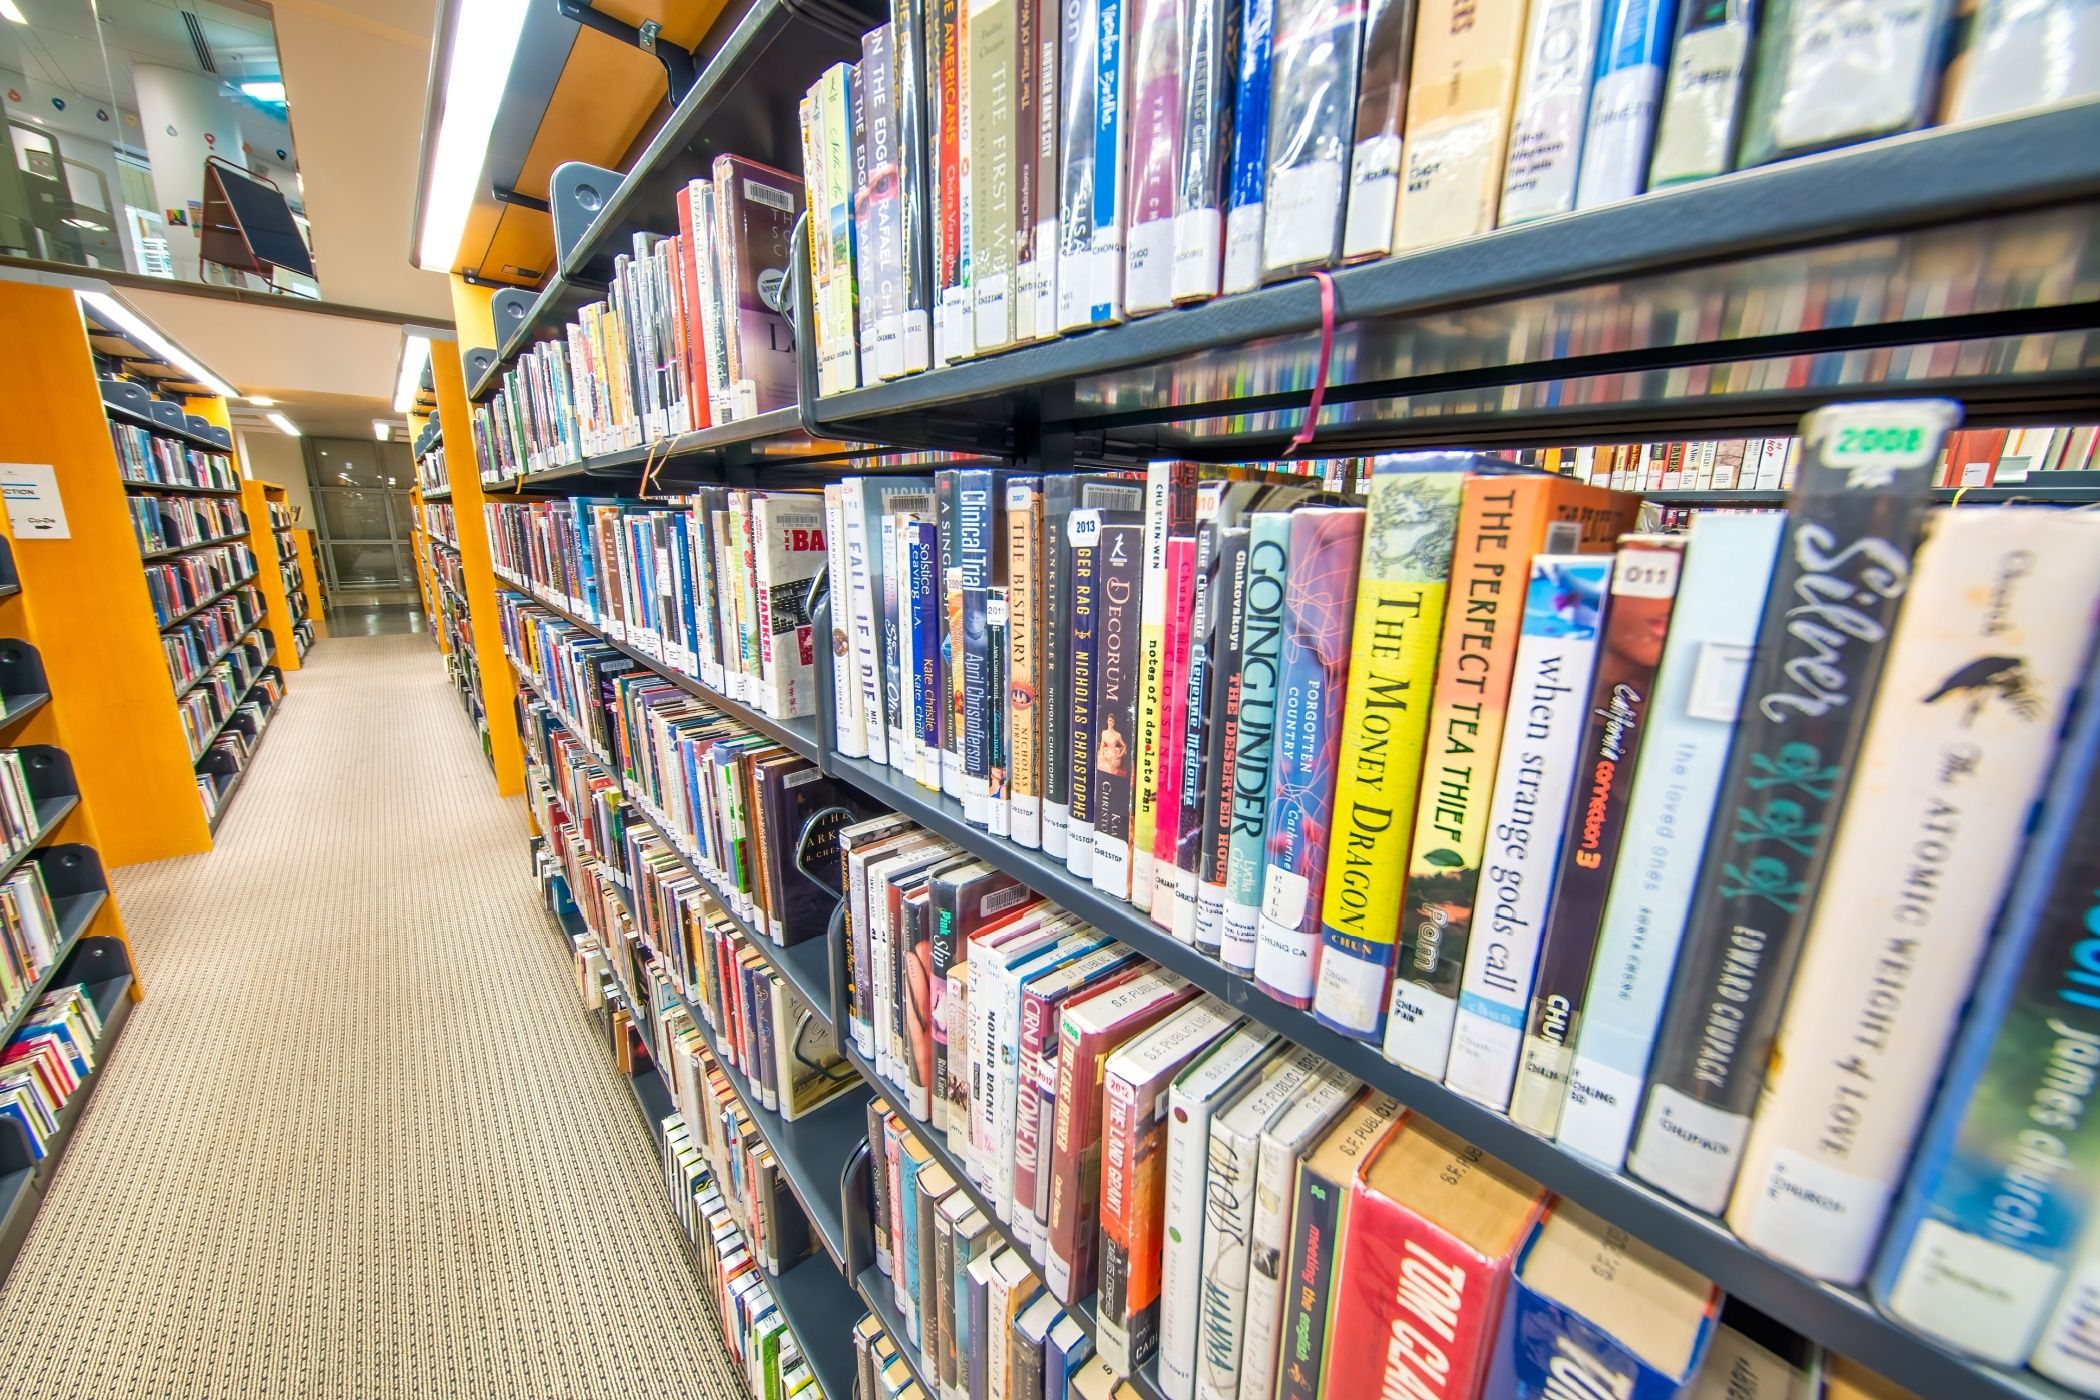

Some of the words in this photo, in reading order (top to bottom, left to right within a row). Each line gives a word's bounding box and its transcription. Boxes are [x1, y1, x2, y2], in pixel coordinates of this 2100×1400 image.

[873, 63, 886, 107] THE
[944, 23, 956, 144] AMERICANS
[991, 60, 1007, 121] THE
[874, 121, 888, 169] EDGE
[991, 134, 1007, 214] FIRST
[855, 99, 865, 137] THE
[860, 223, 872, 287] RAFAEL
[946, 164, 958, 210] Chitra
[878, 200, 891, 270] RAFAEL
[1834, 426, 1922, 455] 2008
[940, 502, 952, 514] A
[960, 489, 987, 551] Clinical
[1155, 484, 1163, 507] CHU
[1476, 489, 1517, 553] THE
[1012, 522, 1026, 562] THE
[1076, 519, 1096, 534] 2013
[1152, 511, 1163, 569] T'IEN-WEN
[911, 543, 921, 600] Leaving
[920, 543, 932, 595] Solstice
[942, 521, 953, 592] SINGLE
[961, 553, 988, 592] Trial
[1048, 525, 1057, 612] FRANKLIN
[760, 589, 772, 664] BANKER
[913, 605, 921, 630] L.A.
[1012, 574, 1027, 669] BESTIARY
[1076, 585, 1091, 616] RAG
[1193, 574, 1208, 638] Chuculate
[1229, 550, 1247, 651] Chukovskaya
[1241, 540, 1286, 691] GOING
[1370, 591, 1424, 660] THE
[1454, 562, 1506, 694] PERFECT
[1758, 522, 1910, 724] Silver
[966, 652, 985, 677] April
[1048, 622, 1056, 671] FLYER
[1105, 576, 1131, 702] DECORUM
[1147, 640, 1158, 682] notes
[914, 674, 922, 700] Kate
[924, 658, 934, 686] Kate
[1073, 651, 1089, 725] NICHOLAS
[1147, 686, 1161, 704] of
[1187, 644, 1207, 727] Cheyenne
[1226, 672, 1241, 715] THE
[1526, 655, 1573, 740] when
[924, 689, 936, 731] Christie
[964, 677, 985, 772] Christofferson
[1158, 650, 1174, 792] CROSSINGS
[1283, 687, 1299, 760] COUNTRY
[1300, 680, 1320, 773] FORGOTTEN
[1356, 671, 1411, 792] MONEY
[1443, 702, 1484, 754] TEA
[1595, 683, 1641, 760] California
[1021, 726, 1029, 788] NICHOLAS
[1047, 736, 1055, 795] CHRISTOPHER
[1143, 720, 1155, 783] desolate
[1183, 733, 1203, 806] Madonna
[1218, 720, 1240, 827] DESERTED
[1231, 698, 1274, 839] UNDER
[1669, 742, 1697, 777] the
[1433, 765, 1473, 843] THIEF
[1497, 752, 1549, 860] strange
[1582, 760, 1616, 850] connection
[1656, 786, 1688, 840] loved
[1094, 847, 1123, 862] CHRISTOP
[1282, 809, 1301, 871] Catherine
[1340, 801, 1393, 931] DRAGON
[1576, 848, 1600, 869] 3
[1642, 846, 1670, 892] ones
[1893, 799, 1963, 929] ATOMIC
[1242, 859, 1258, 893] Lydia
[1488, 865, 1531, 936] gods
[932, 935, 950, 967] Slip
[939, 910, 952, 936] Pink
[1330, 933, 1373, 955] CHUN
[1412, 901, 1450, 973] Pam
[967, 961, 979, 993] RITA
[1078, 953, 1110, 972] PUBLIC
[1482, 943, 1519, 993] call
[1717, 925, 1767, 1001] EDWARD
[1111, 992, 1132, 1009] S.F.
[1131, 978, 1166, 1000] PUBLIC
[1467, 1001, 1513, 1025] chun
[1854, 937, 1921, 1055] WEIGHT
[968, 1001, 980, 1053] CIRESI
[986, 1009, 996, 1068] MOTHER
[1062, 1044, 1074, 1068] THE
[1143, 1044, 1166, 1061] S.F.
[1160, 1025, 1194, 1053] PUBLIC
[1692, 1002, 1745, 1087] CHUPACK
[1018, 1044, 1040, 1081] THE
[1059, 1067, 1072, 1101] CASE
[2025, 1017, 2100, 1131] james
[985, 1071, 995, 1125] ROCKET
[1016, 1083, 1038, 1139] COME
[1109, 1099, 1127, 1128] THE
[1251, 1096, 1274, 1116] S.F.
[1266, 1069, 1300, 1104] PUBLIC
[1107, 1128, 1126, 1167] LAND
[1338, 1128, 1366, 1157] S.F.
[1356, 1102, 1393, 1140] PUBLIC
[1818, 1085, 1869, 1160] LOVE
[1015, 1139, 1037, 1173] ON
[1170, 1138, 1184, 1213] ETHER
[1440, 1163, 1466, 1187] S.F.
[1106, 1168, 1123, 1217] GRANT
[1986, 1128, 2076, 1245] church
[1301, 1224, 1322, 1286] meeting
[1300, 1285, 1316, 1311] the
[1396, 1239, 1467, 1344] TOM
[1204, 1276, 1235, 1372] MANNA
[1295, 1311, 1311, 1362] english
